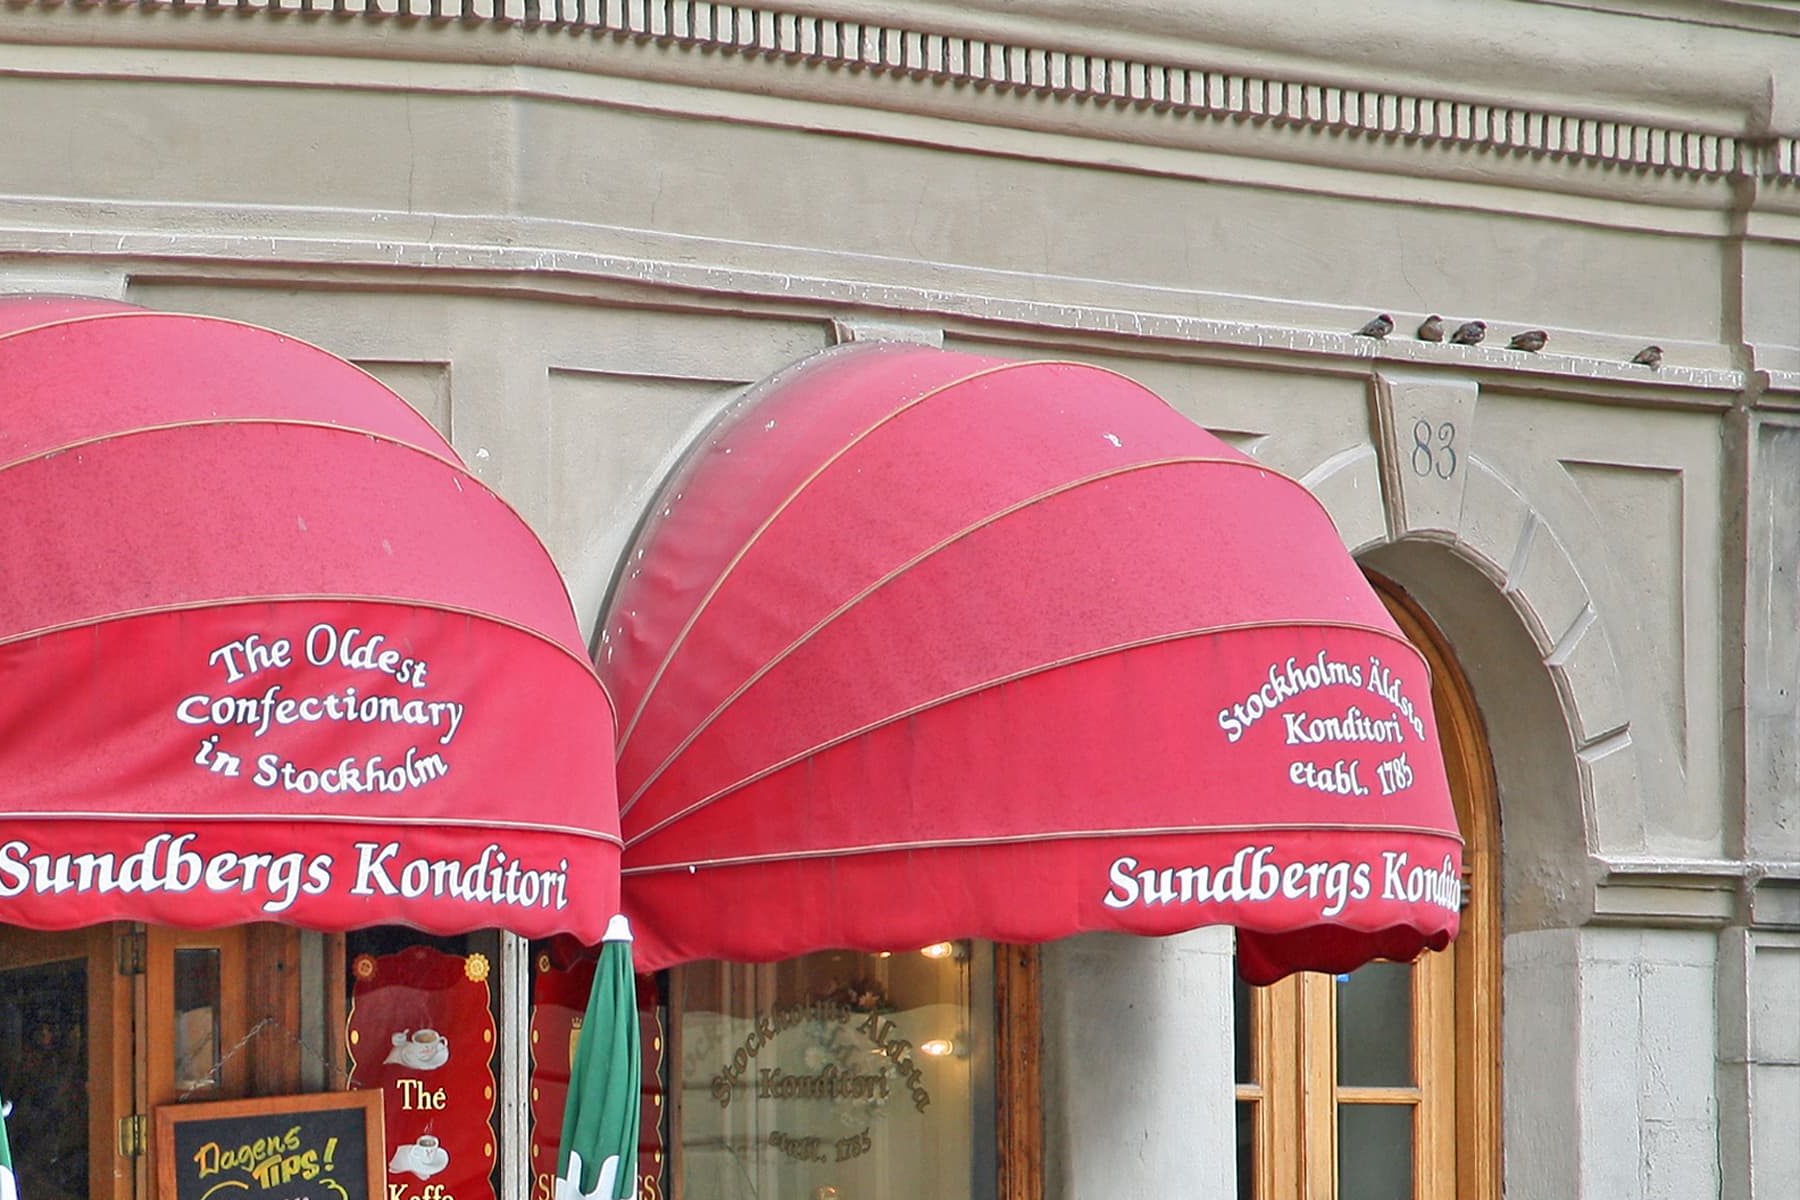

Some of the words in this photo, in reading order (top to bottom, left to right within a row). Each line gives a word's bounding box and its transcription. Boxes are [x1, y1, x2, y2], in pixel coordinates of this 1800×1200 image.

[1411, 418, 1458, 480] 83
[209, 634, 292, 684] The
[305, 622, 428, 689] Oldest
[1217, 649, 1363, 744] Stockholms
[1367, 656, 1426, 742] Äldsta
[1282, 705, 1404, 745] Konditori
[194, 734, 241, 777] in
[253, 747, 449, 796] Stockholm
[1289, 759, 1369, 797] etabl.
[1376, 751, 1414, 796] 1785
[350, 840, 570, 911] Konditori
[1102, 846, 1371, 918] Sundbergs
[397, 1079, 448, 1111] Thé
[758, 1064, 890, 1099] Konditori
[193, 1125, 303, 1179] Dagens
